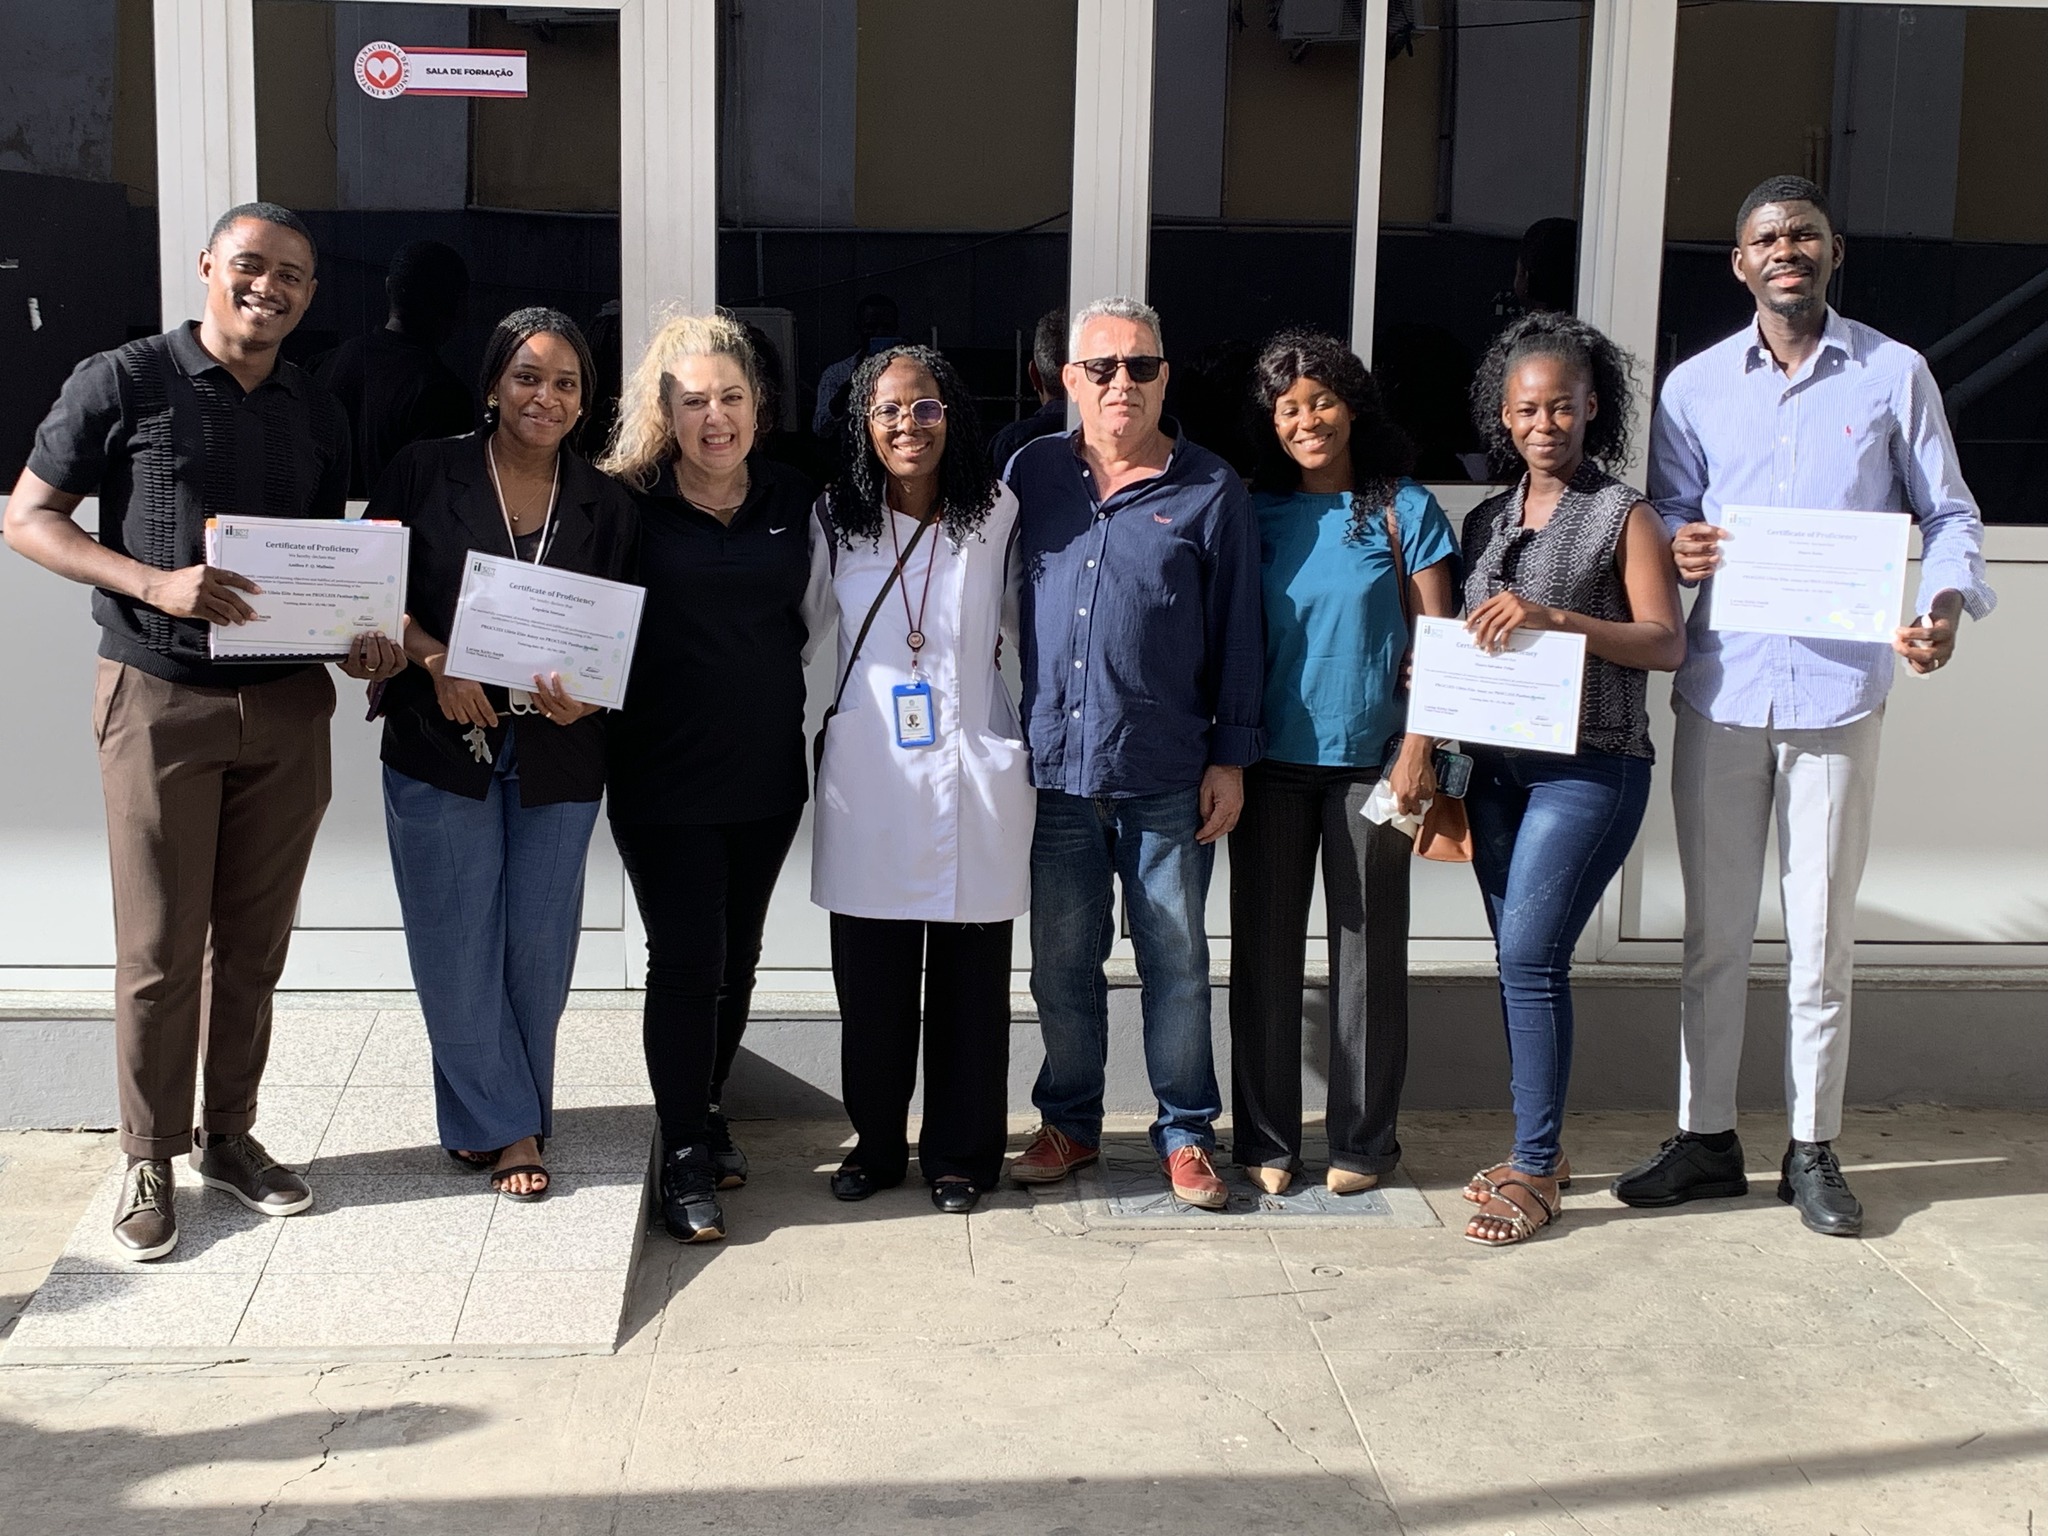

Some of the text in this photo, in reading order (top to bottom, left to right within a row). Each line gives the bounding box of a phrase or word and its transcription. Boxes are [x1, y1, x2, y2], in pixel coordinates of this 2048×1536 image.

[356, 43, 409, 96] INSTITUTO NACIONAL DE SANGUE
[464, 68, 513, 78] FORMAÇÃO
[265, 541, 359, 555] Certificate of Proficiency
[509, 582, 596, 607] Certificate of Proficiency
